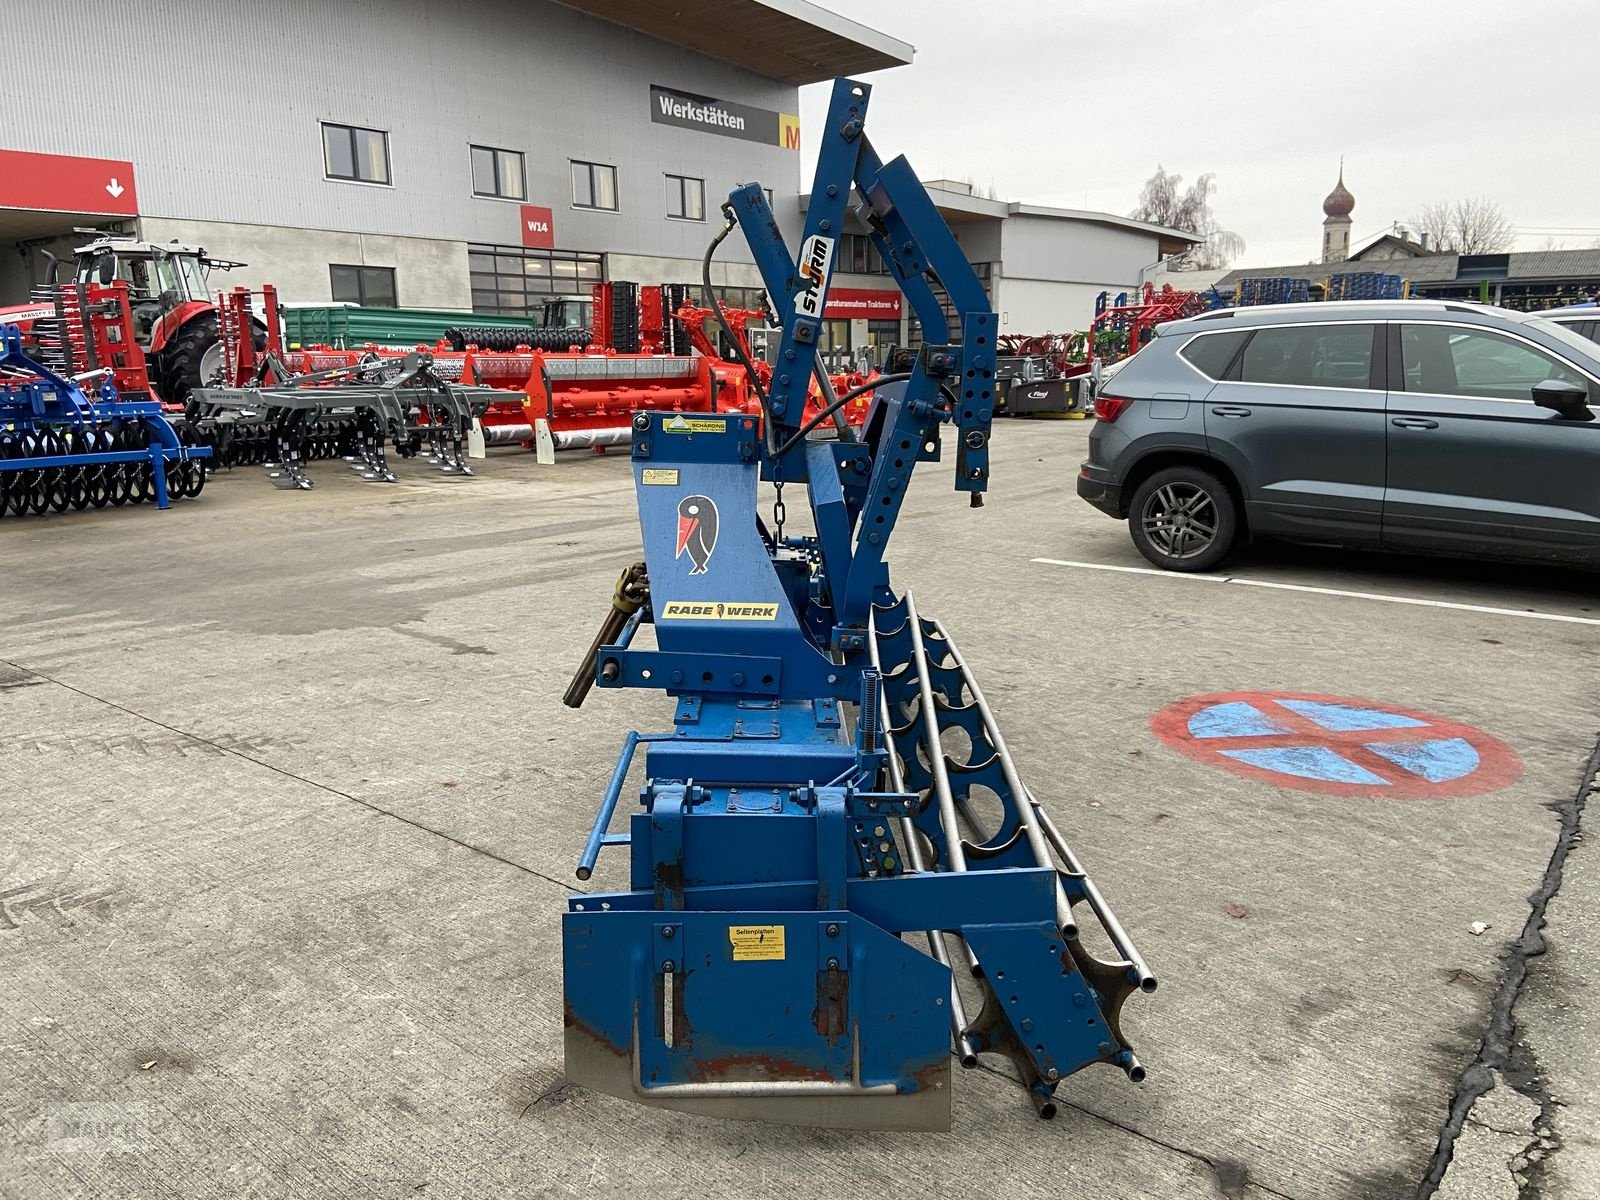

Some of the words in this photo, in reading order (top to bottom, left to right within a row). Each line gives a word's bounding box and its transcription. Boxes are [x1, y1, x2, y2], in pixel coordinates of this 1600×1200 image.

[659, 96, 745, 130] Werkstätten
[527, 221, 548, 232] W14
[867, 300, 892, 309] Traktoren
[667, 605, 714, 615] RABE
[727, 607, 775, 616] WERK
